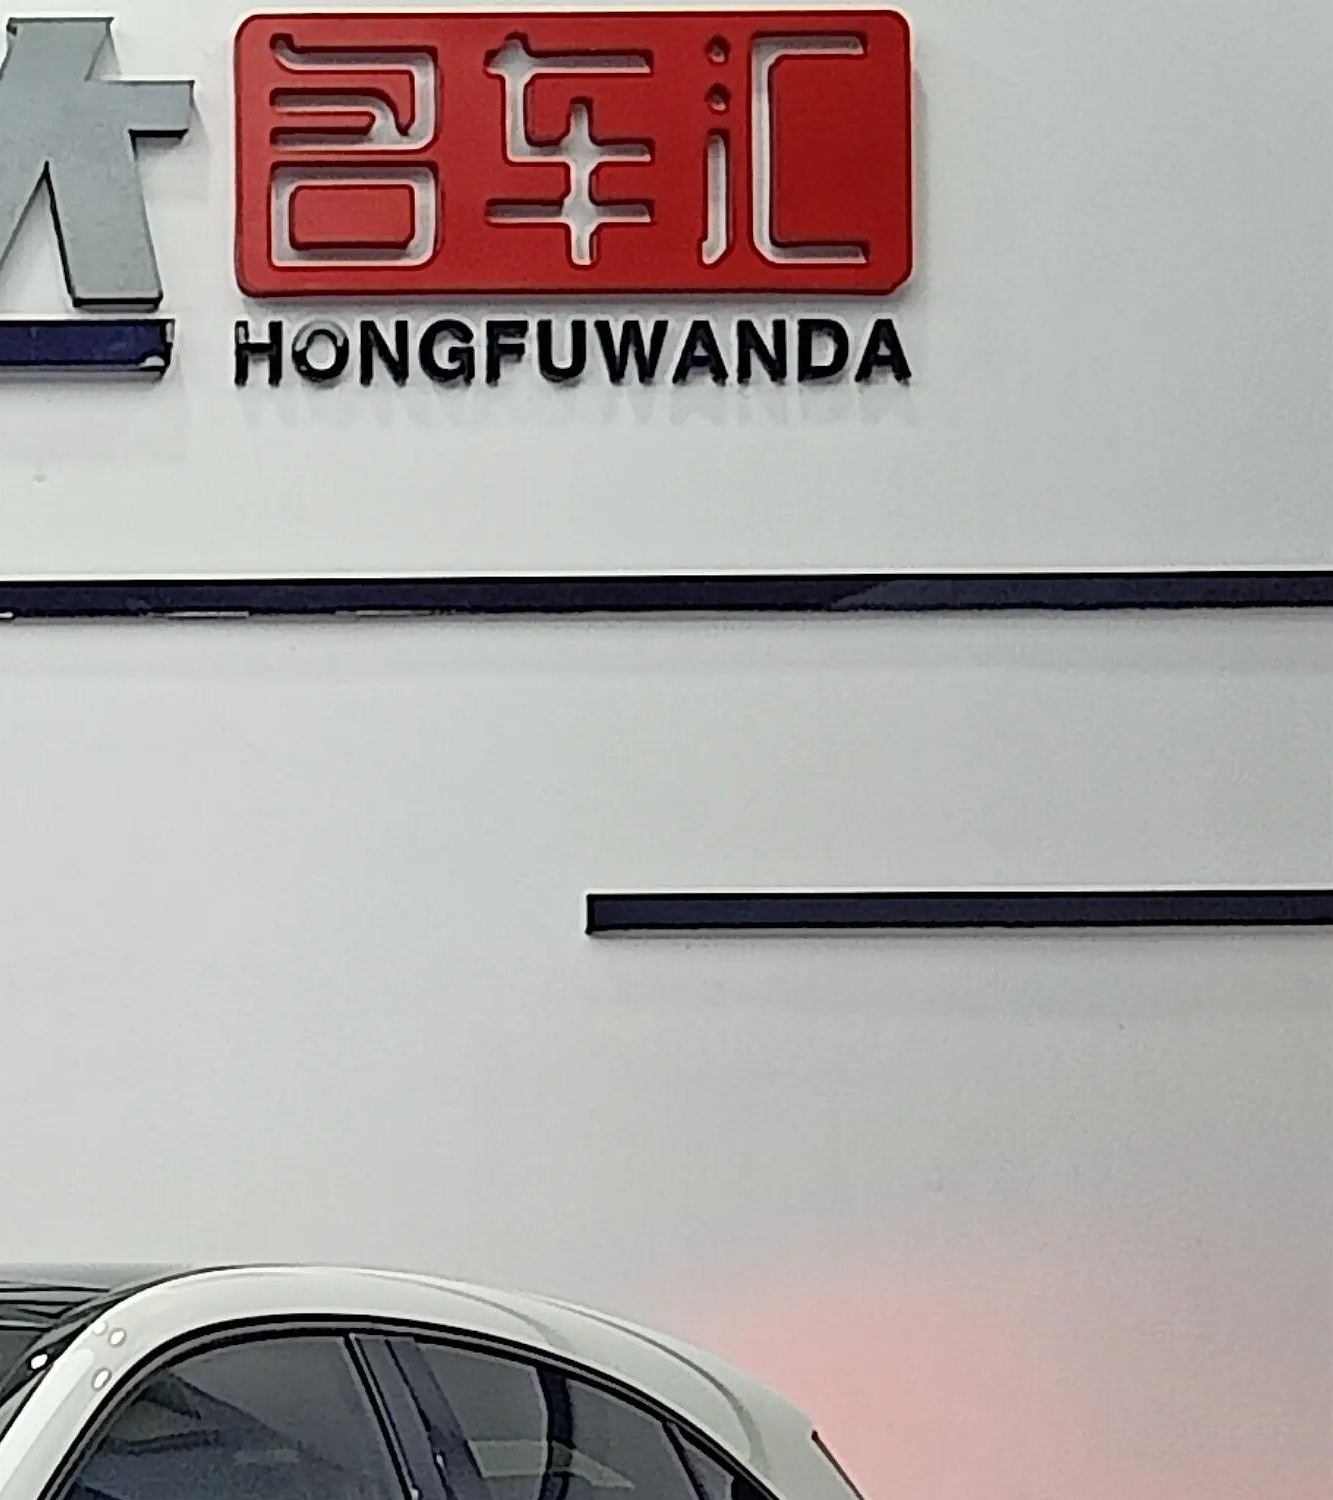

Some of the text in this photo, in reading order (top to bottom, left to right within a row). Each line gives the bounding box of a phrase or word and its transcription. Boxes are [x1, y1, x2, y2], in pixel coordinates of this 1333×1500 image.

[267, 30, 871, 268] 名车汇
[233, 318, 913, 388] HONGFUWANDA
